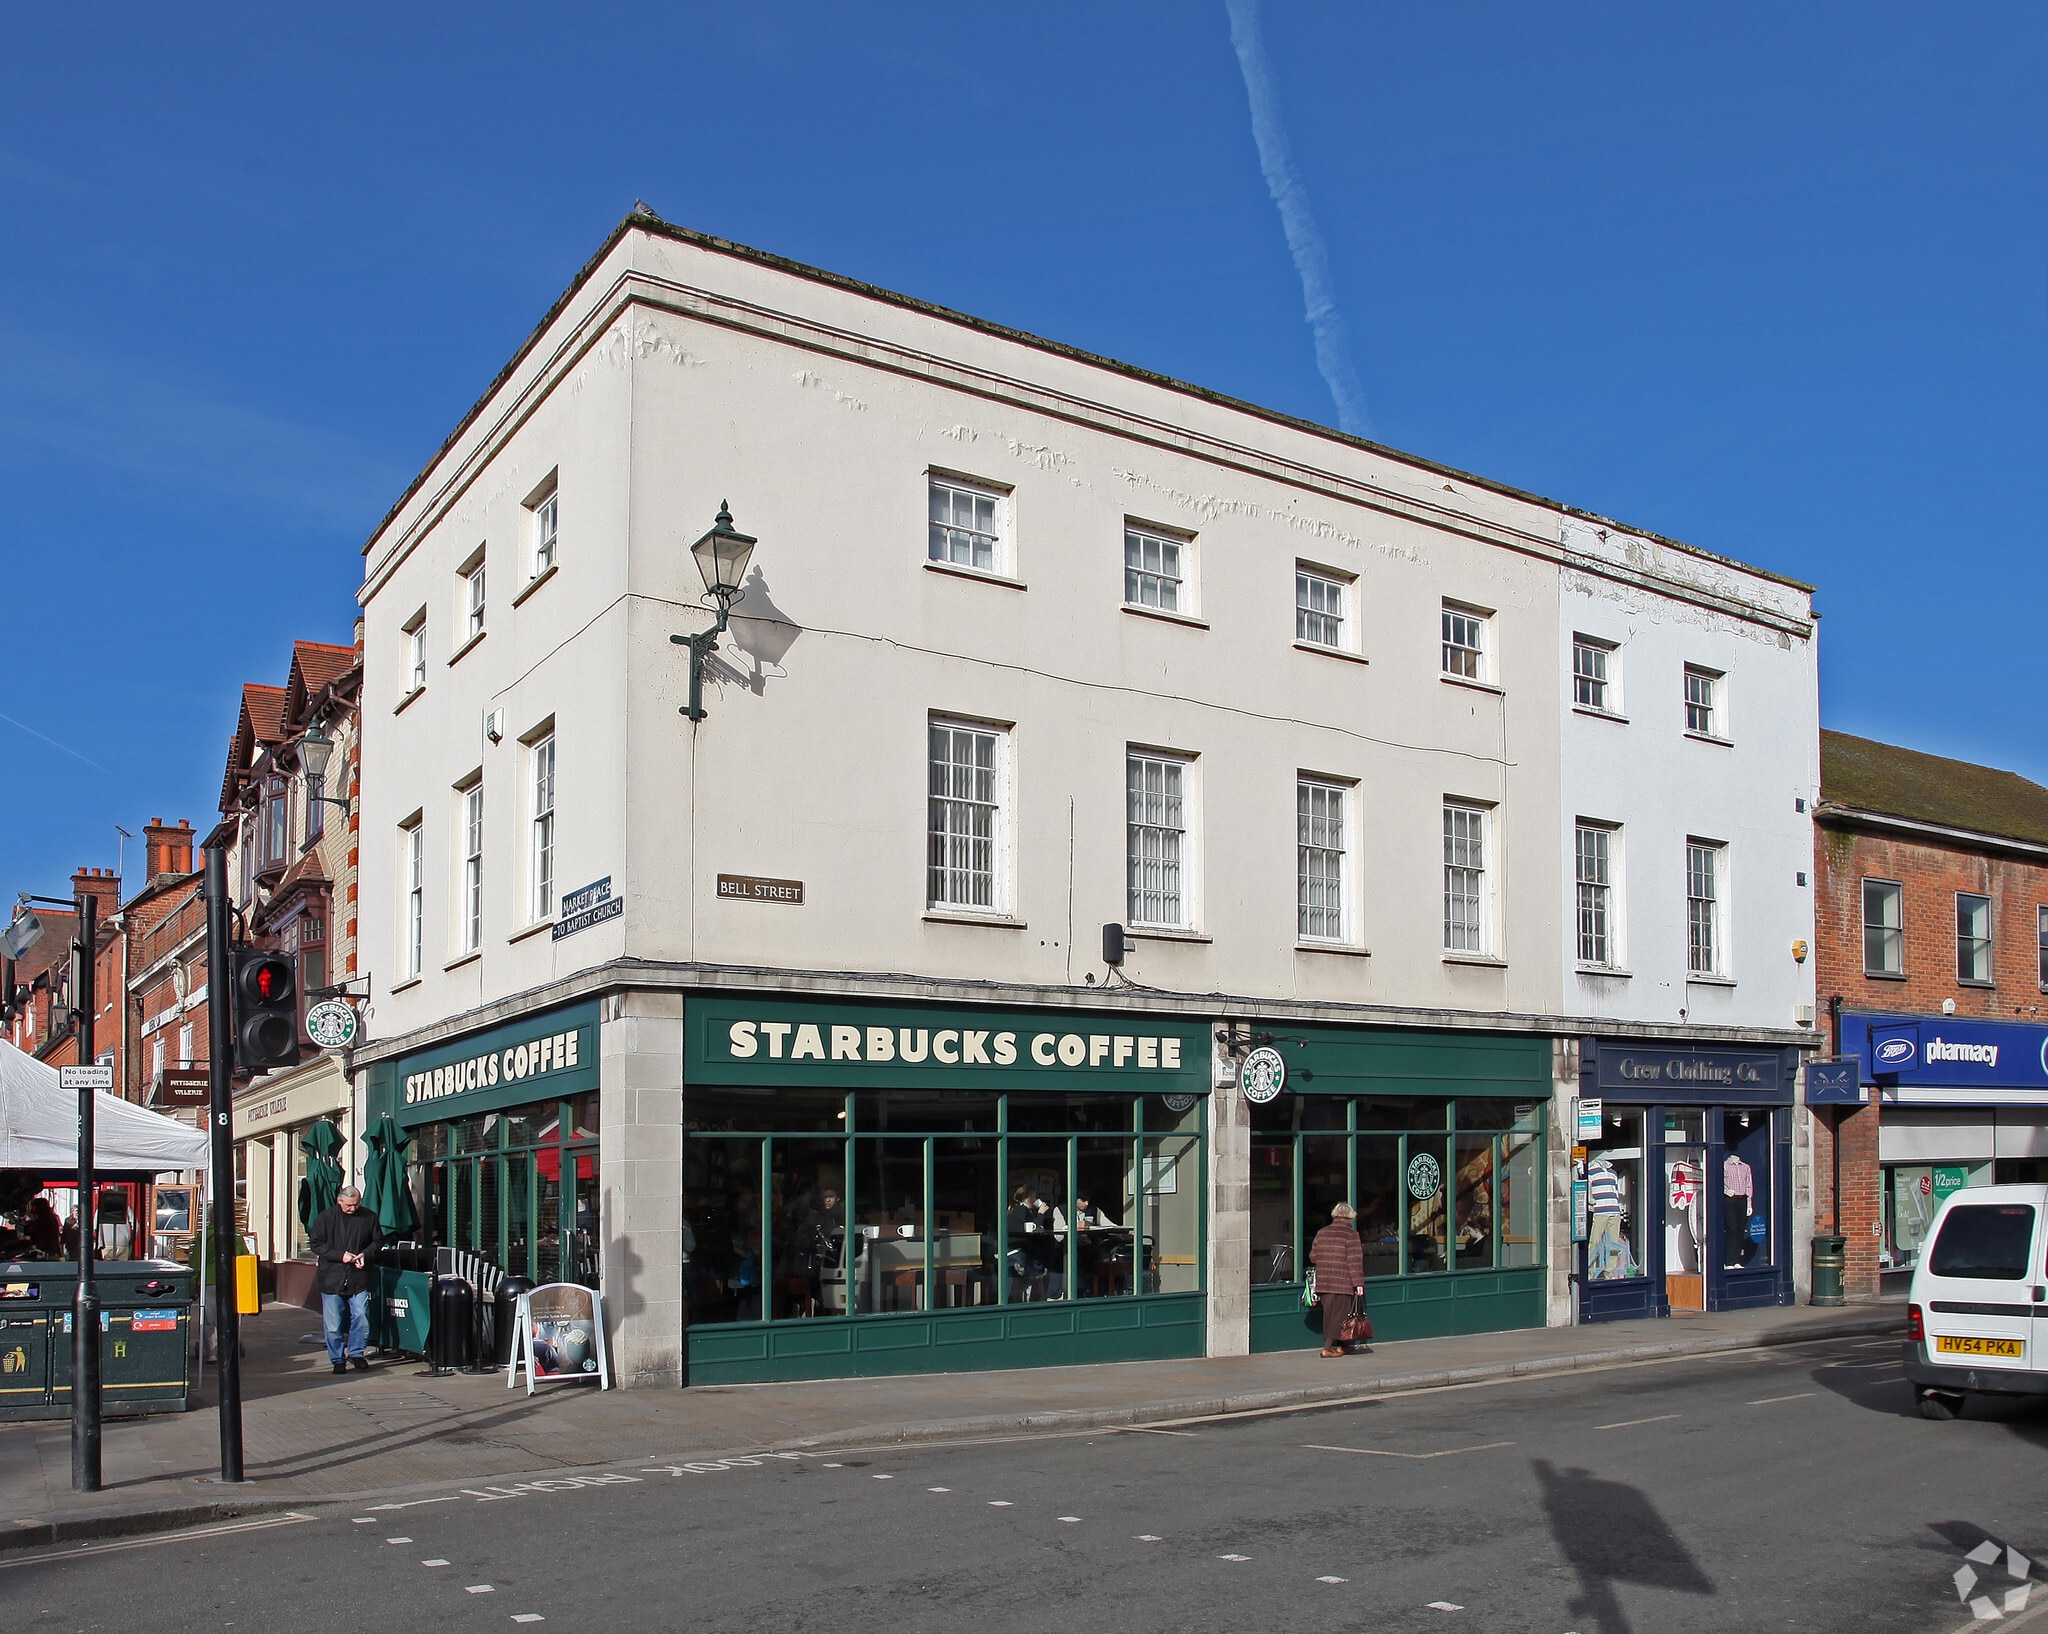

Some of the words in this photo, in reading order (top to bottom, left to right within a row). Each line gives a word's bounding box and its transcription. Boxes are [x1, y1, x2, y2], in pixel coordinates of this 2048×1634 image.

[720, 881, 750, 896] BELL
[754, 884, 801, 899] STREET
[563, 891, 589, 913] MARKET
[557, 923, 565, 937] TO
[567, 912, 592, 933] BAPTIST
[592, 900, 621, 922] CHURCH
[310, 1004, 353, 1026] STARBUCKS
[312, 1030, 346, 1045] COFFEE
[728, 1019, 1018, 1066] STARBUCKS
[1029, 1032, 1182, 1069] COFFEE
[1244, 1051, 1281, 1076] STARBUCKS
[1926, 1037, 1998, 1068] pharmacy
[79, 1068, 109, 1076] loading
[406, 1053, 499, 1104] STARBUCKS
[502, 1029, 578, 1082] COFFEE
[1620, 1058, 1661, 1080] Crew
[1666, 1059, 1733, 1085] Clothing
[1247, 1083, 1277, 1100] COFFEE
[218, 1112, 228, 1126] 8
[1410, 1155, 1438, 1176] STARBUCKS
[1411, 1184, 1434, 1197] COFFEE
[1943, 1337, 1982, 1352] HV54
[1985, 1340, 2015, 1354] PKA
[640, 1450, 800, 1477] LOOK
[460, 1473, 644, 1503] RIGHT
